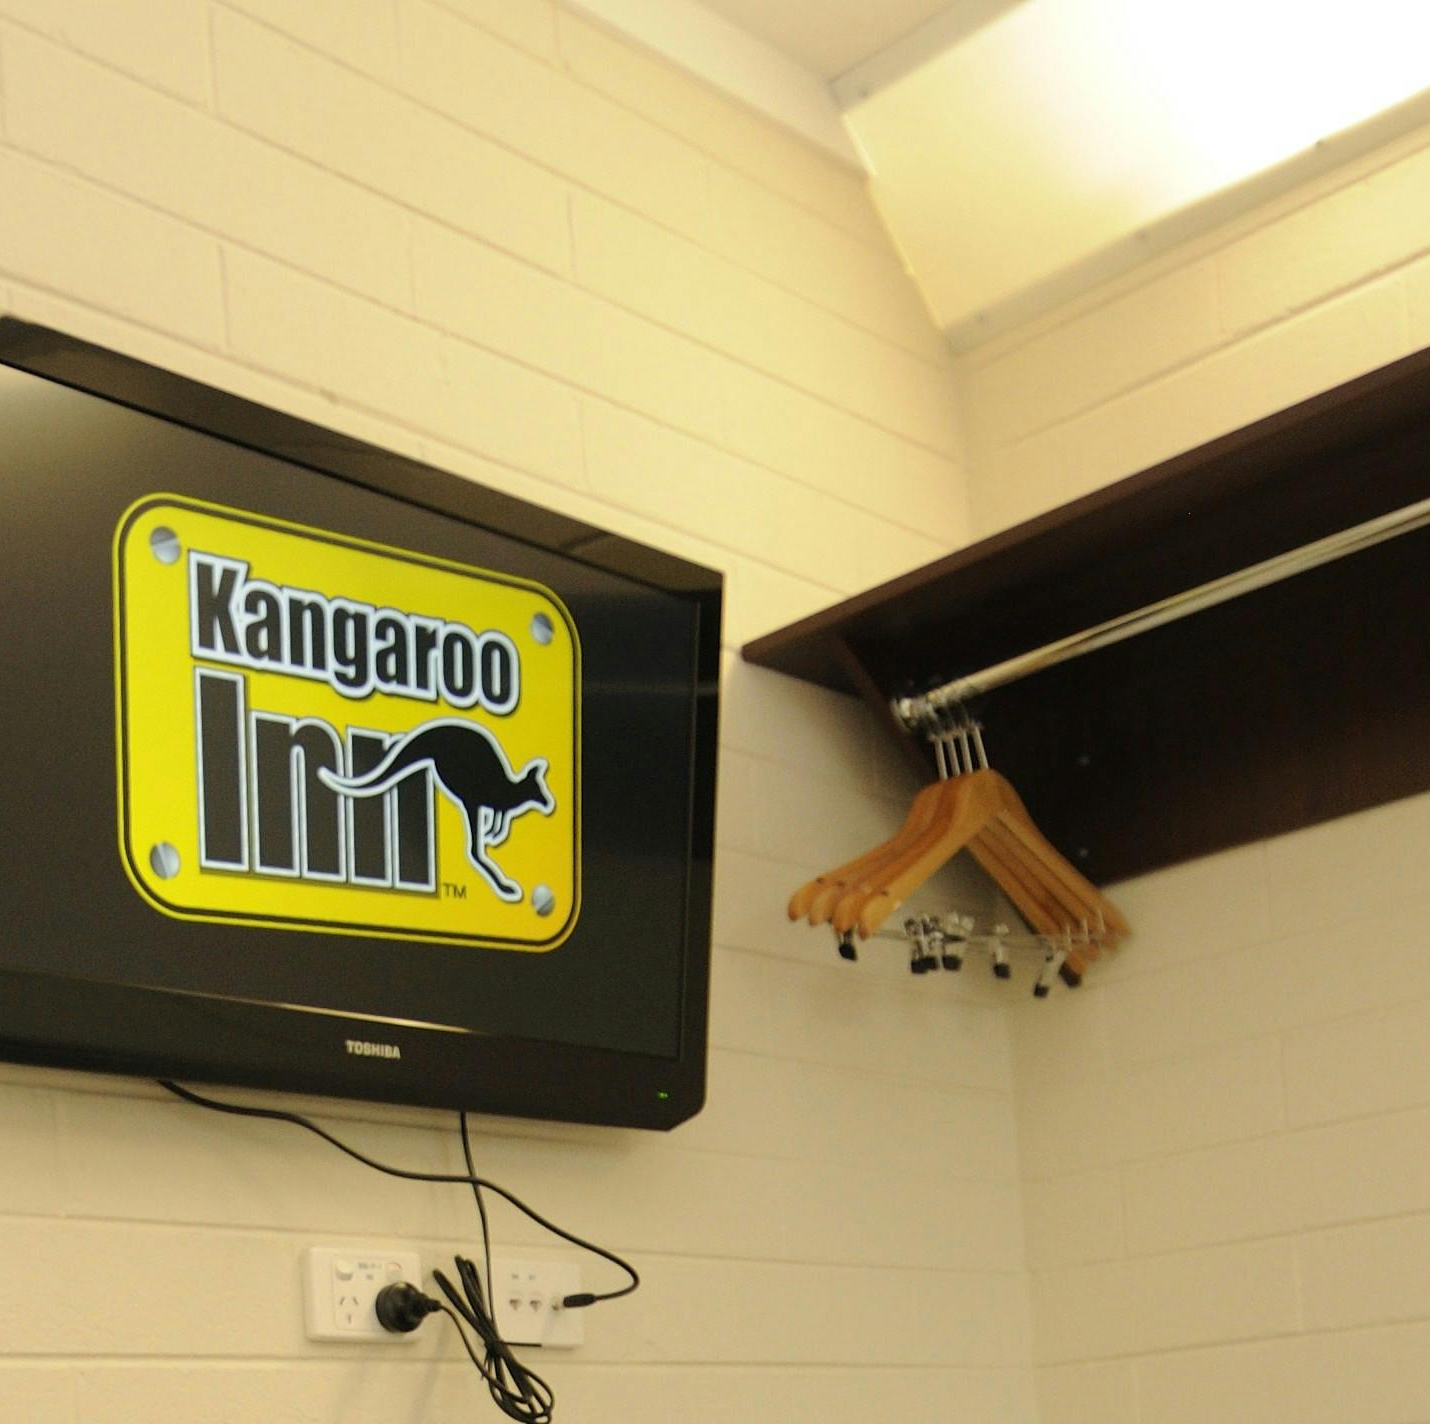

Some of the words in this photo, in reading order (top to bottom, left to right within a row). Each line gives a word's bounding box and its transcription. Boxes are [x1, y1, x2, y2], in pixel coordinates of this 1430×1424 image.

[189, 550, 519, 715] Kangaroo
[194, 666, 439, 894] Inn
[444, 883, 467, 899] TM
[345, 1039, 402, 1059] TOSHIBA
